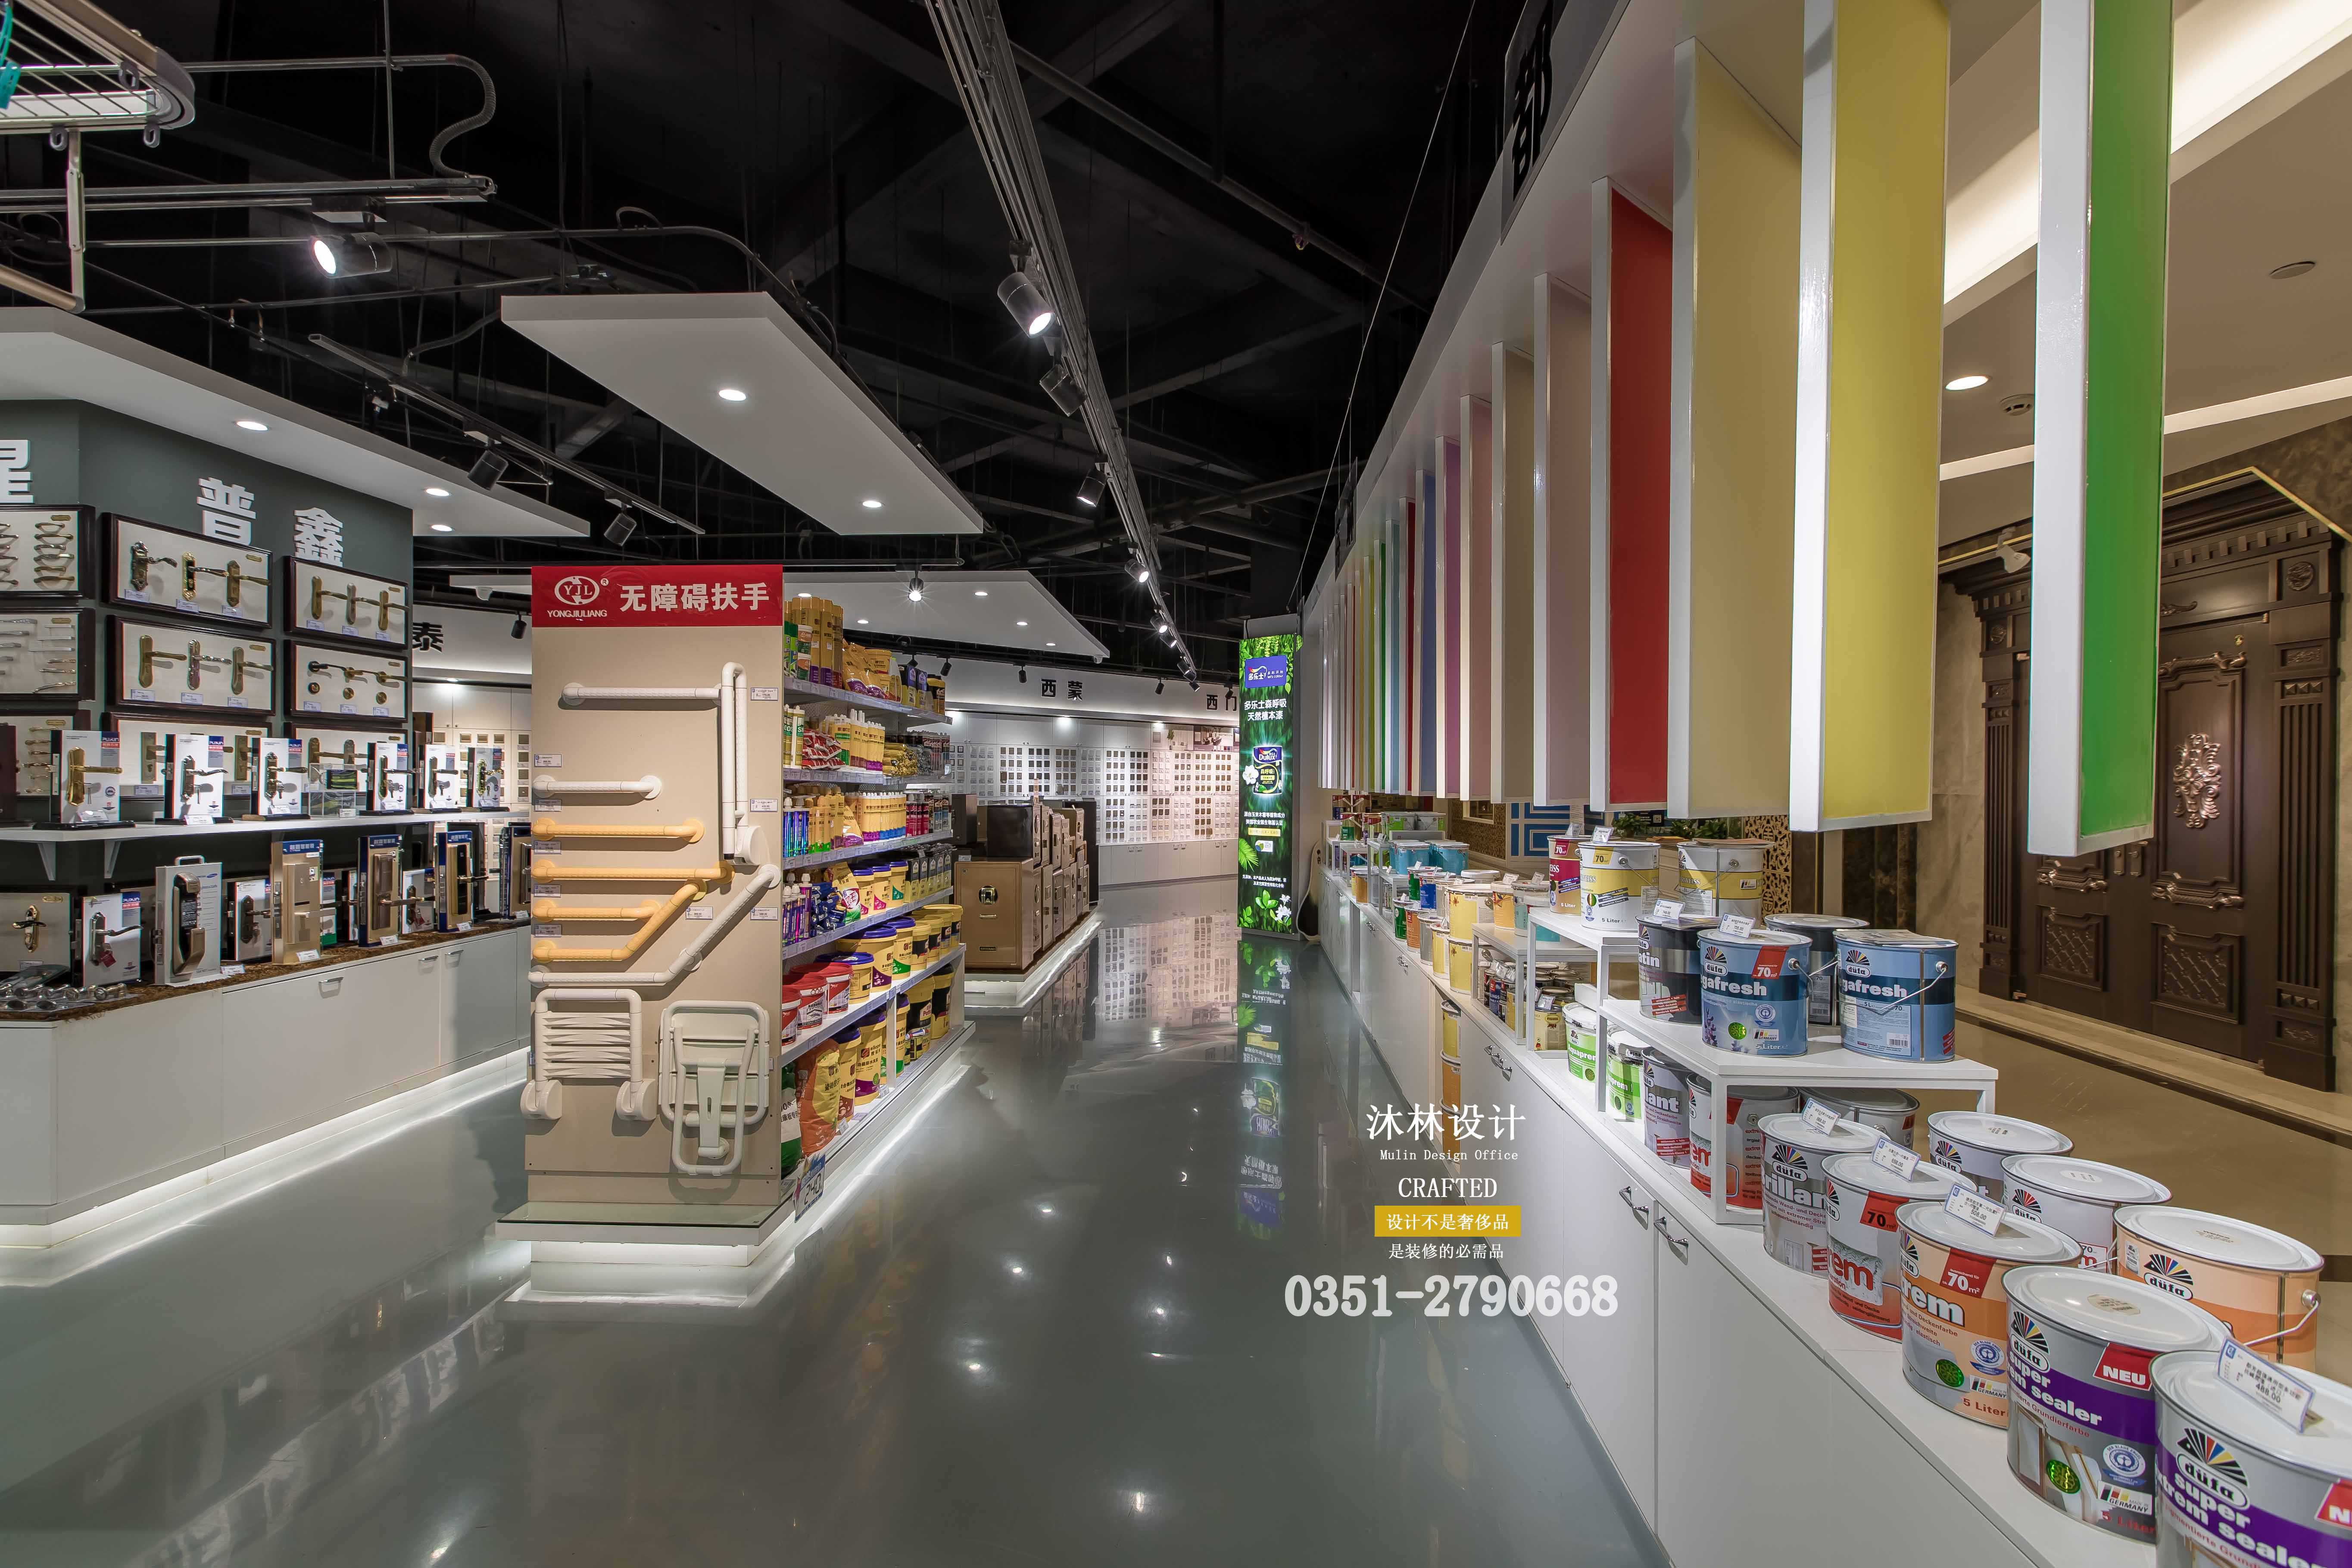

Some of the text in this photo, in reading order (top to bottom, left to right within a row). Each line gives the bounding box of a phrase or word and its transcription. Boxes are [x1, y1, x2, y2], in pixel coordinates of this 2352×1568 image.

[564, 585, 592, 595] YJL
[620, 583, 770, 612] 无障碍扶手
[547, 609, 607, 618] YONGJIULIANG
[1041, 678, 1083, 701] 西蒙
[1244, 698, 1287, 710] 多乐士森呼吸
[1248, 711, 1283, 721] 天然植本漆
[1706, 963, 1722, 974] düfa
[1757, 967, 1770, 977] 70
[1848, 967, 1865, 975] düfa
[1701, 974, 1767, 997] gafresh
[1776, 1164, 1802, 1180] düfa
[1938, 1158, 1957, 1172] düfa
[1779, 1200, 1795, 1210] Wand-
[1787, 1210, 1811, 1222] extremer
[1867, 1211, 1886, 1227] 70
[1830, 1251, 1873, 1291] em
[1947, 1272, 1968, 1291] 70
[2150, 1276, 2184, 1297] düfa
[1918, 1312, 1958, 1337] Deckenfarbe
[1916, 1330, 1941, 1347] elastisch
[2014, 1339, 2041, 1367] düfa
[2009, 1351, 2050, 1387] super
[2103, 1365, 2146, 1385] NEU
[1978, 1387, 2007, 1398] GERMANY
[2255, 1383, 2280, 1403] 488.00
[1963, 1398, 2006, 1416] 5 Liter
[2031, 1385, 2102, 1425] sealer
[2032, 1403, 2090, 1437] Grundierfarbe
[2185, 1462, 2234, 1502] düfa
[2109, 1498, 2148, 1513] GERMANY
[2174, 1472, 2250, 1529] super
[2117, 1516, 2155, 1532] Liter
[2218, 1523, 2329, 1568] seale
